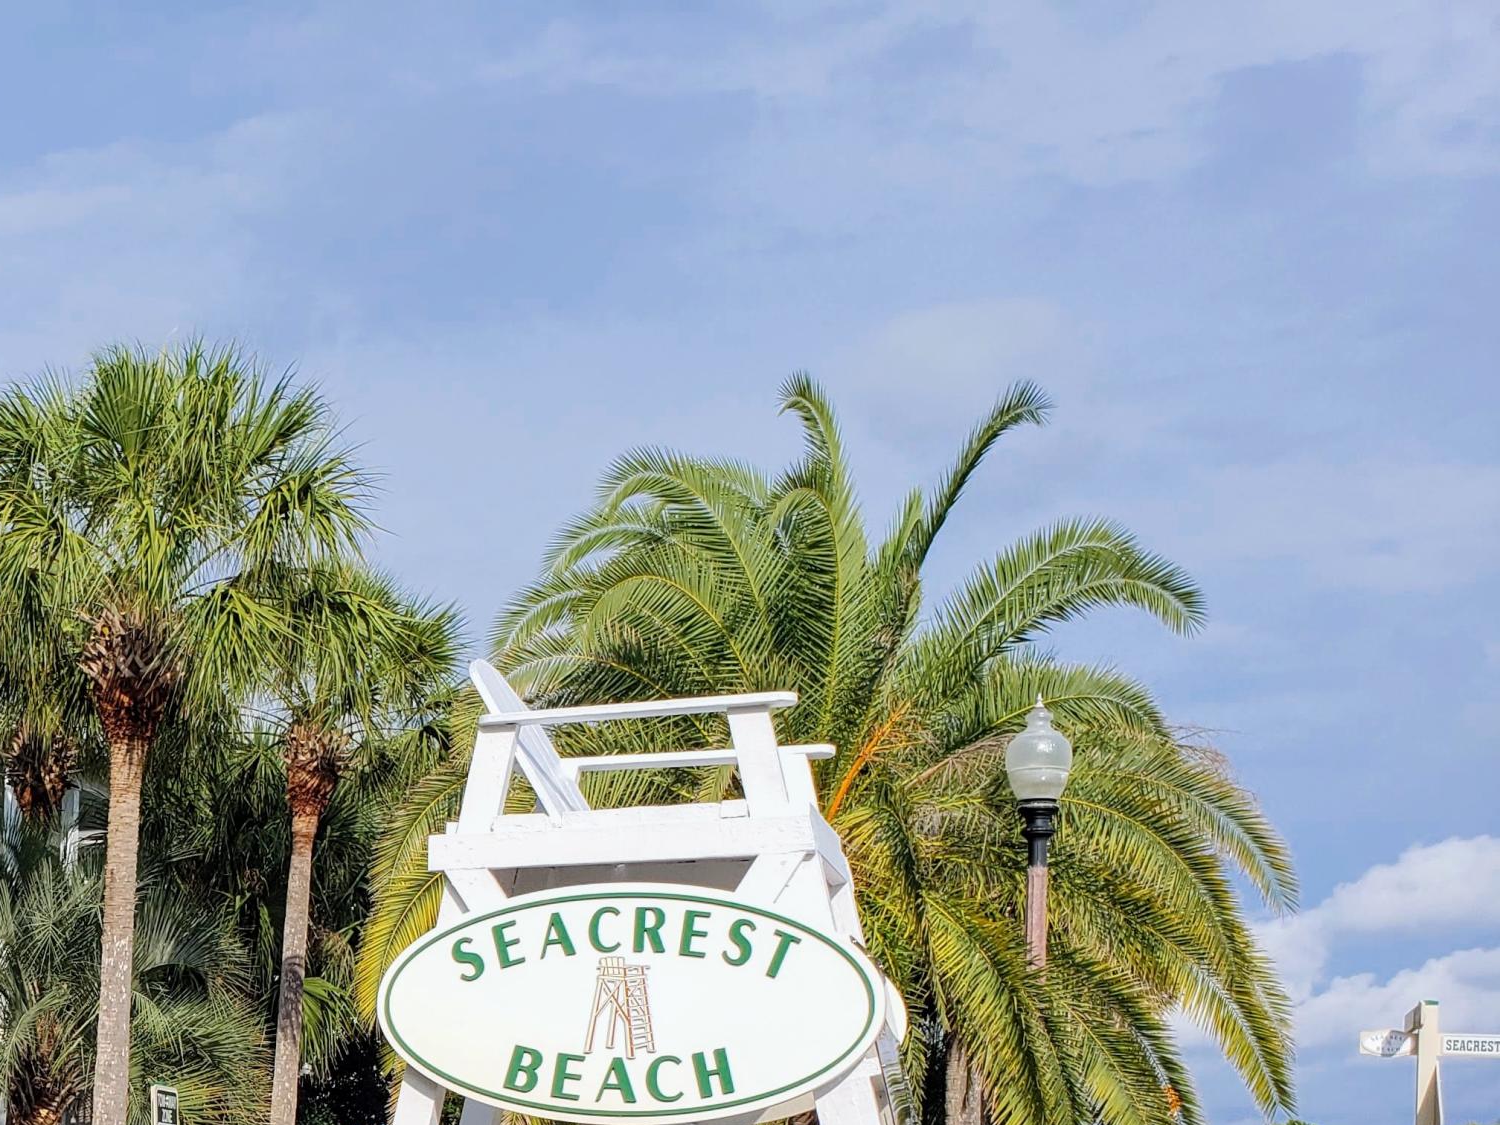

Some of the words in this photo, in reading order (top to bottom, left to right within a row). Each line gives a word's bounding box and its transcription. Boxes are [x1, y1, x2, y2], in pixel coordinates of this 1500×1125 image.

[451, 906, 801, 982] SEACREST
[502, 1044, 735, 1103] BEACH
[1446, 1039, 1500, 1052] SEACREST
